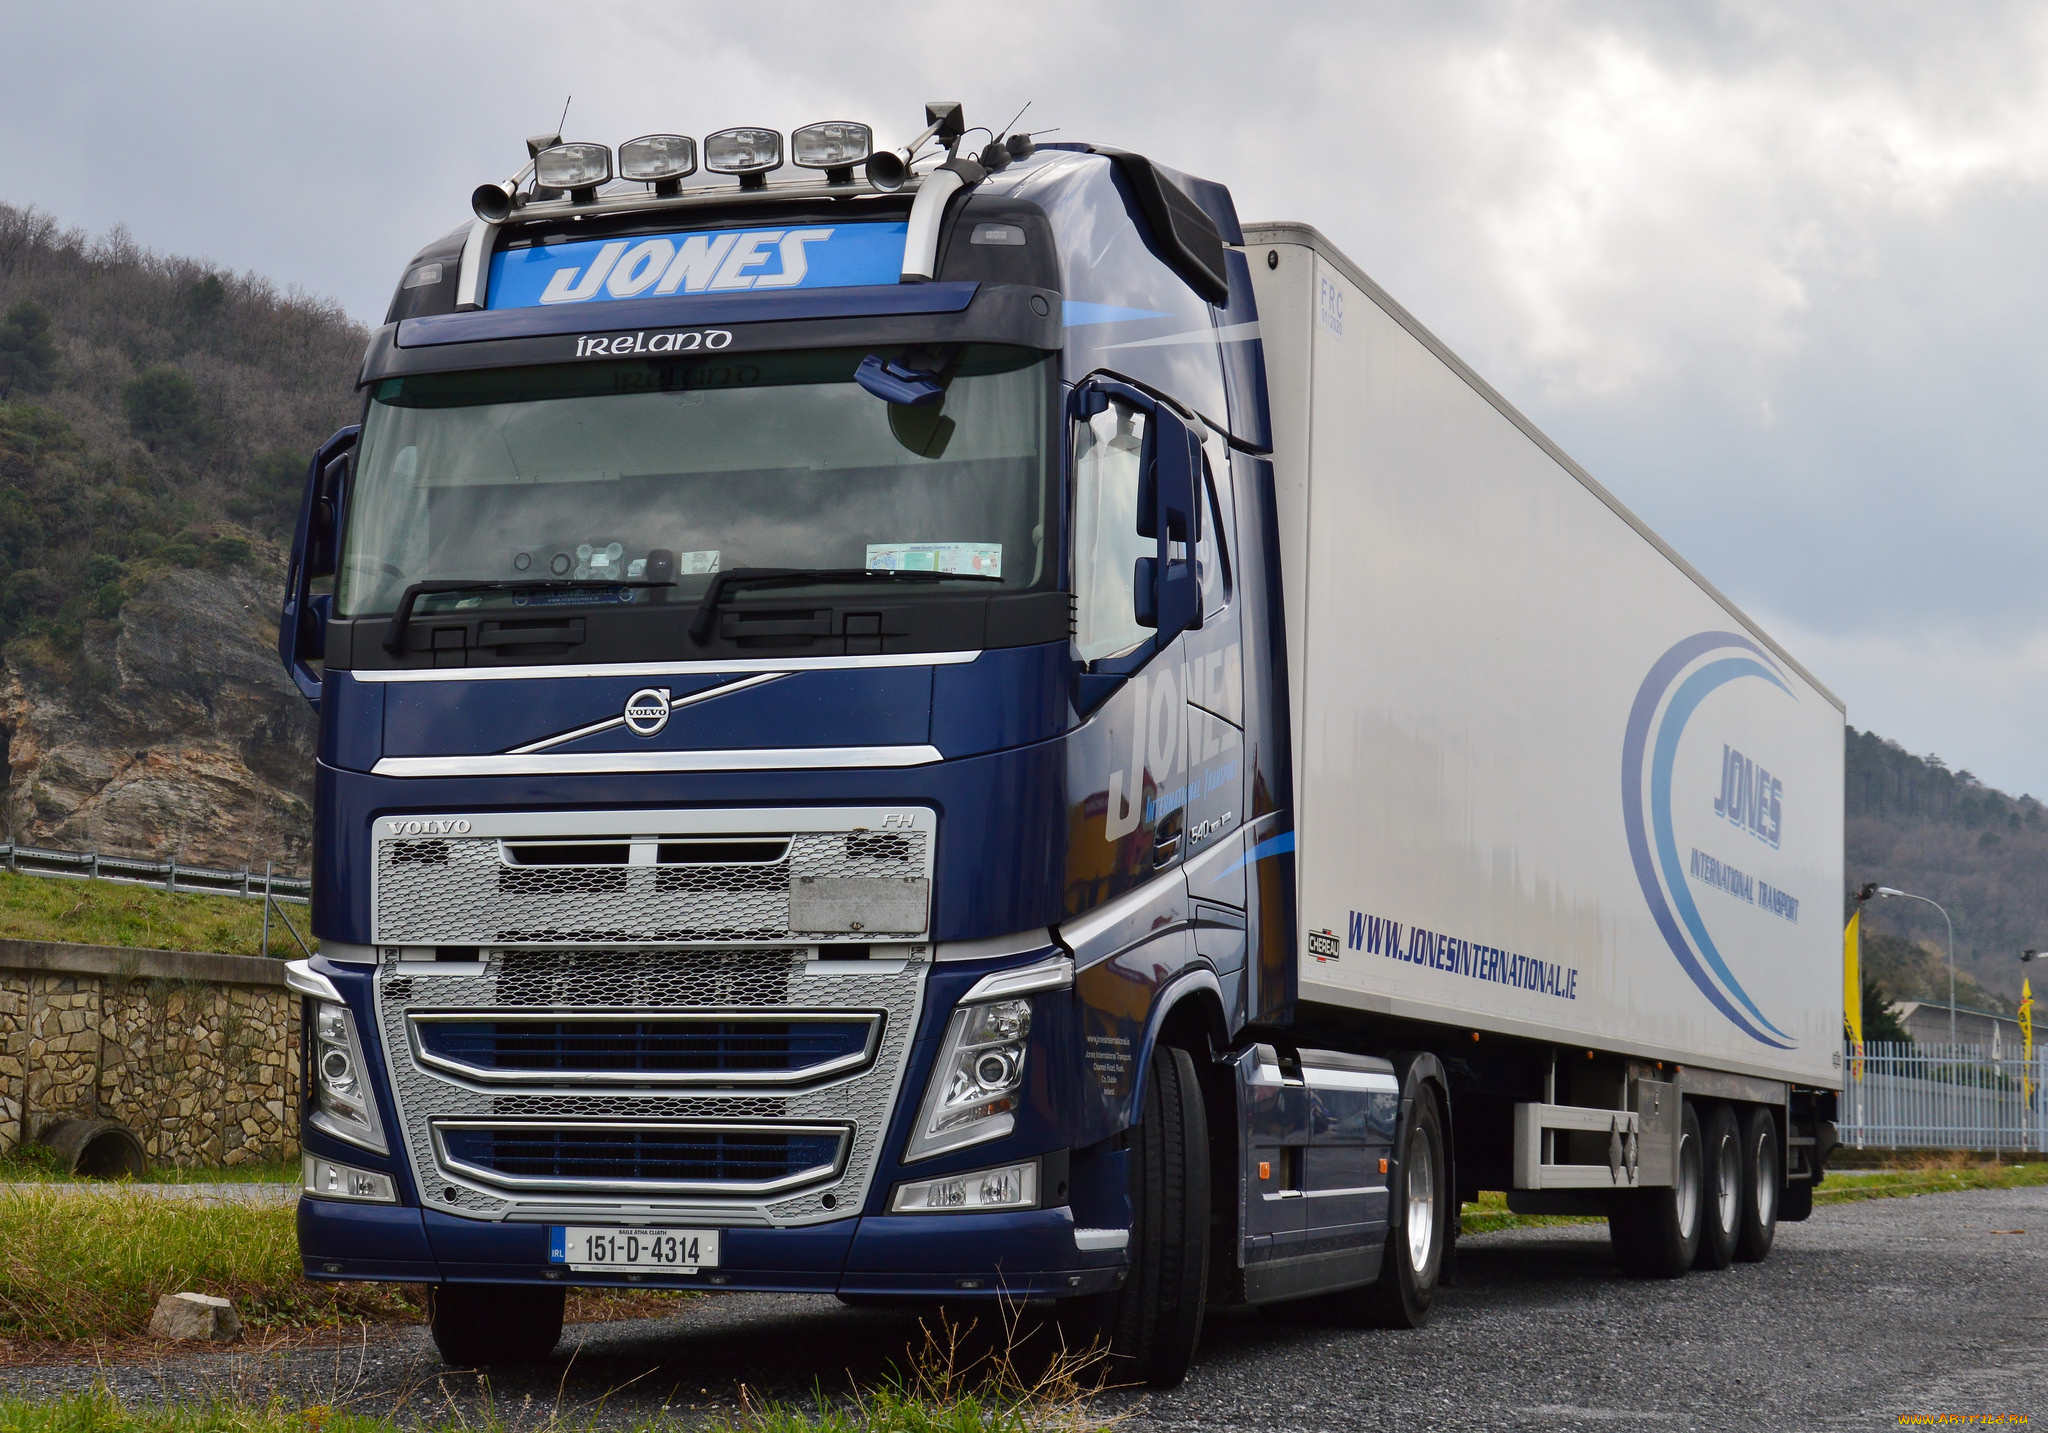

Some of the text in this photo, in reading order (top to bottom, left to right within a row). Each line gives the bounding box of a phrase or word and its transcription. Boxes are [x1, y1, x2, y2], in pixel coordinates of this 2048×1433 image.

[539, 227, 835, 304] JONES
[1105, 642, 1240, 842] JONES
[1145, 778, 1201, 824] INTERNATIONAL
[1203, 759, 1238, 800] TRANSPORT
[1713, 743, 1783, 849] JONES
[386, 819, 472, 835] VOLVO
[882, 813, 915, 828] FH
[1191, 819, 1209, 845] 540
[1690, 847, 1799, 924] INTERNATIONAL TRANSPORT
[1309, 935, 1339, 957] CHEREAU
[1348, 910, 1578, 1000] WWW.JONESINTERNATIONAL.IE
[551, 1249, 564, 1258] IRL
[586, 1235, 700, 1263] 151-D-4314
